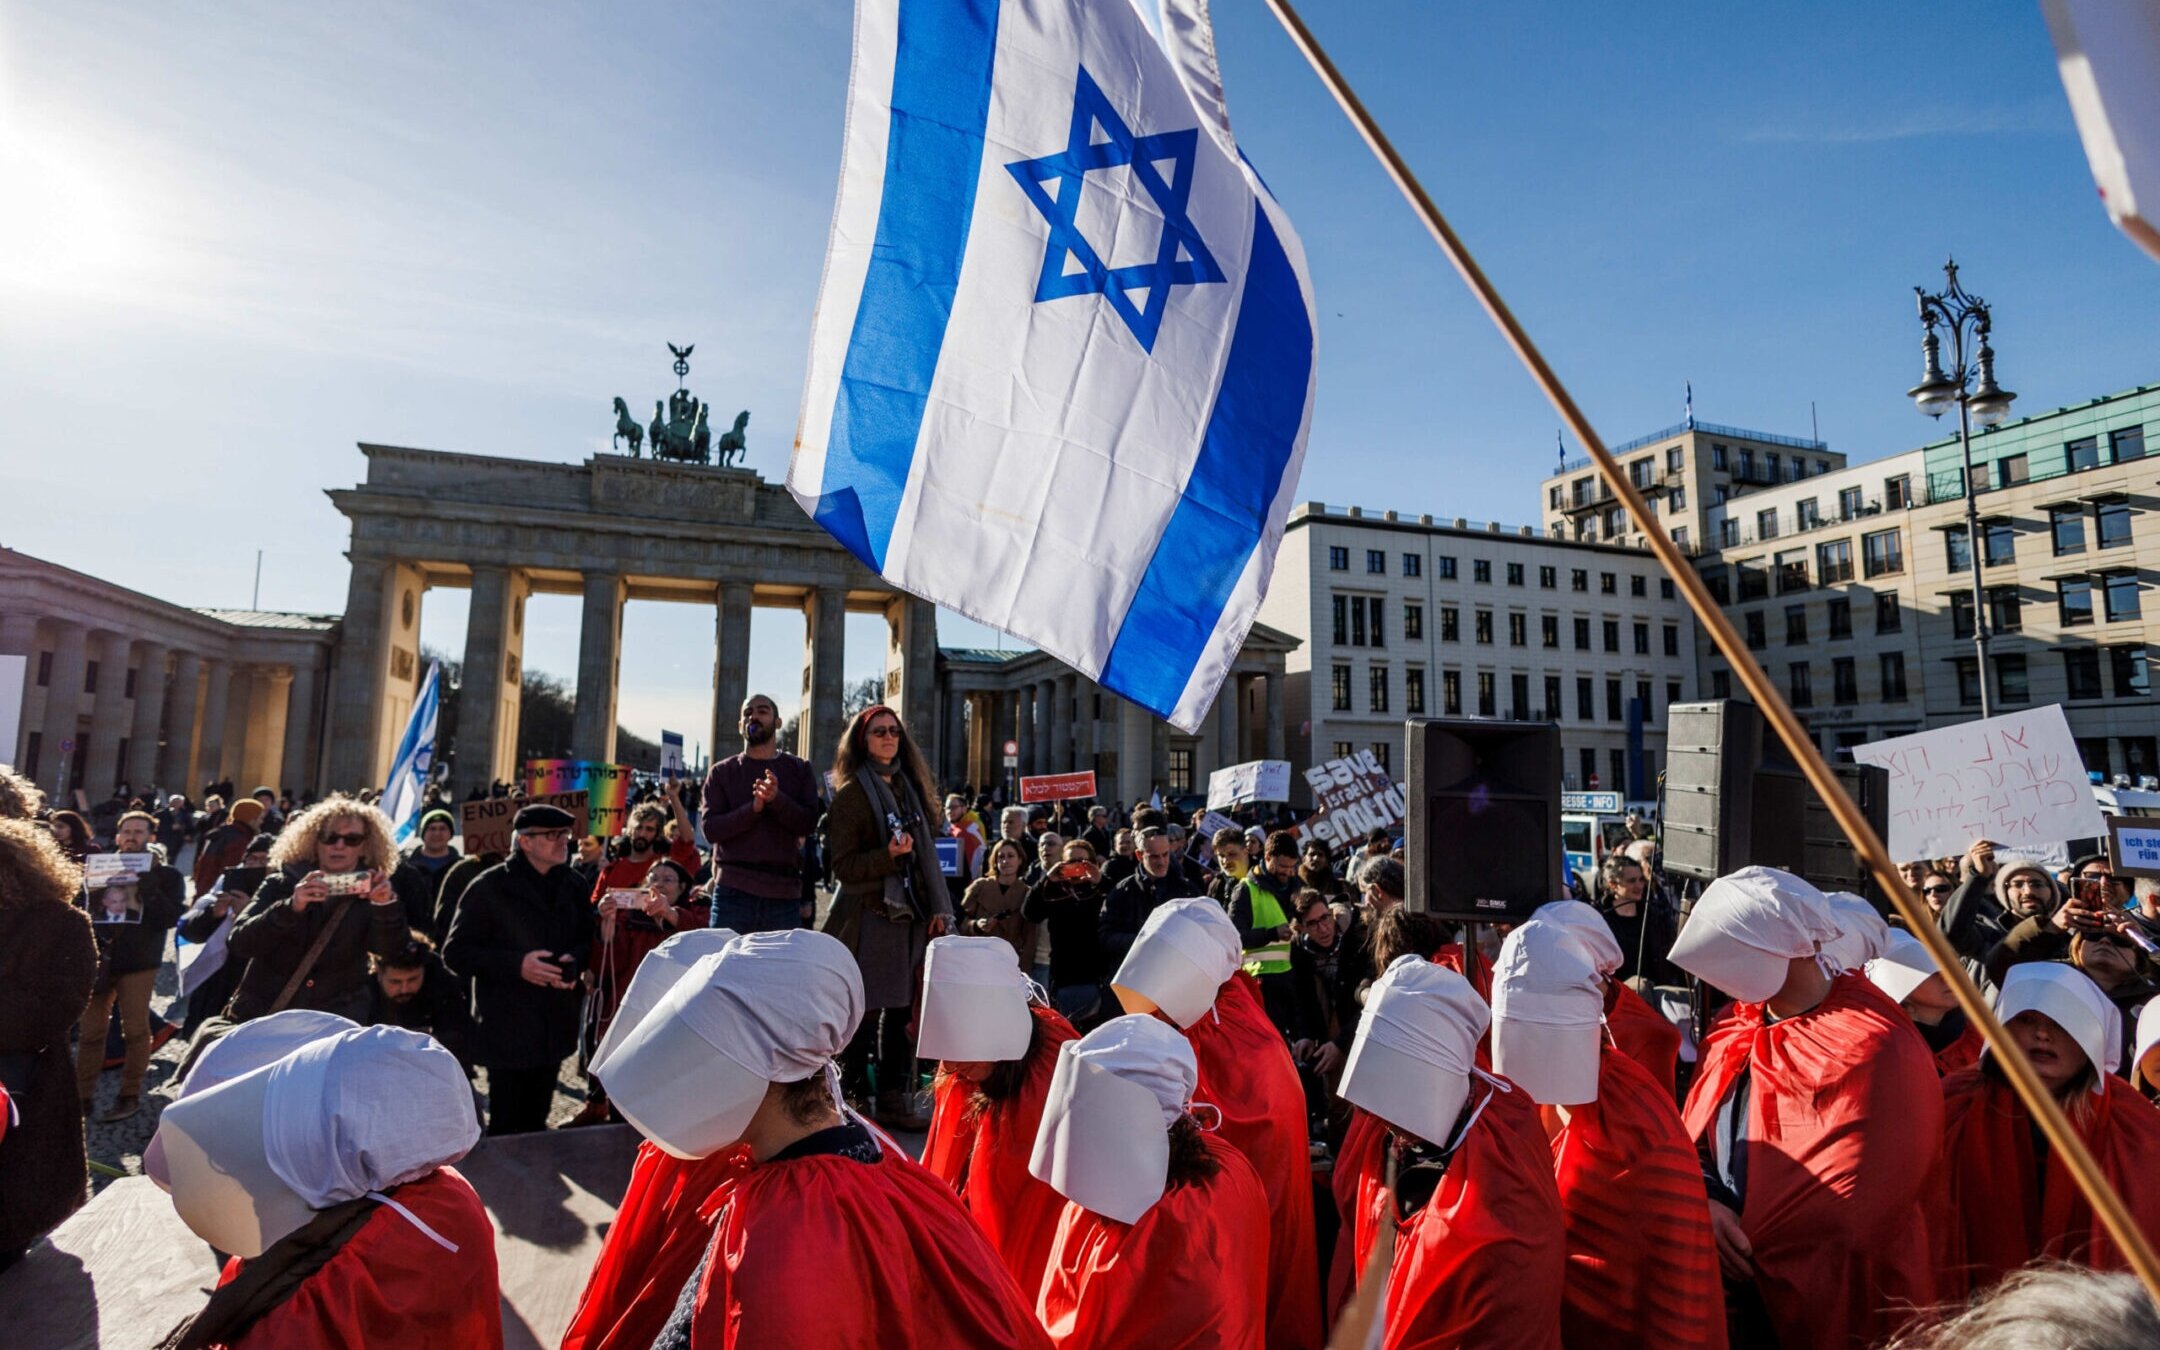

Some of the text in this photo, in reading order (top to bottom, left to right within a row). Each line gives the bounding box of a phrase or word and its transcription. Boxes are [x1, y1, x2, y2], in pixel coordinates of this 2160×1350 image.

[1959, 725, 2029, 763] אני
[1305, 748, 1384, 793] save
[463, 803, 508, 822] END
[550, 790, 589, 809] COUP
[1325, 775, 1374, 809] israeli
[1561, 796, 1587, 808] RESSE
[1593, 796, 1613, 808] INFO
[588, 807, 623, 825] דיקט
[2138, 848, 2158, 861] FÜR
